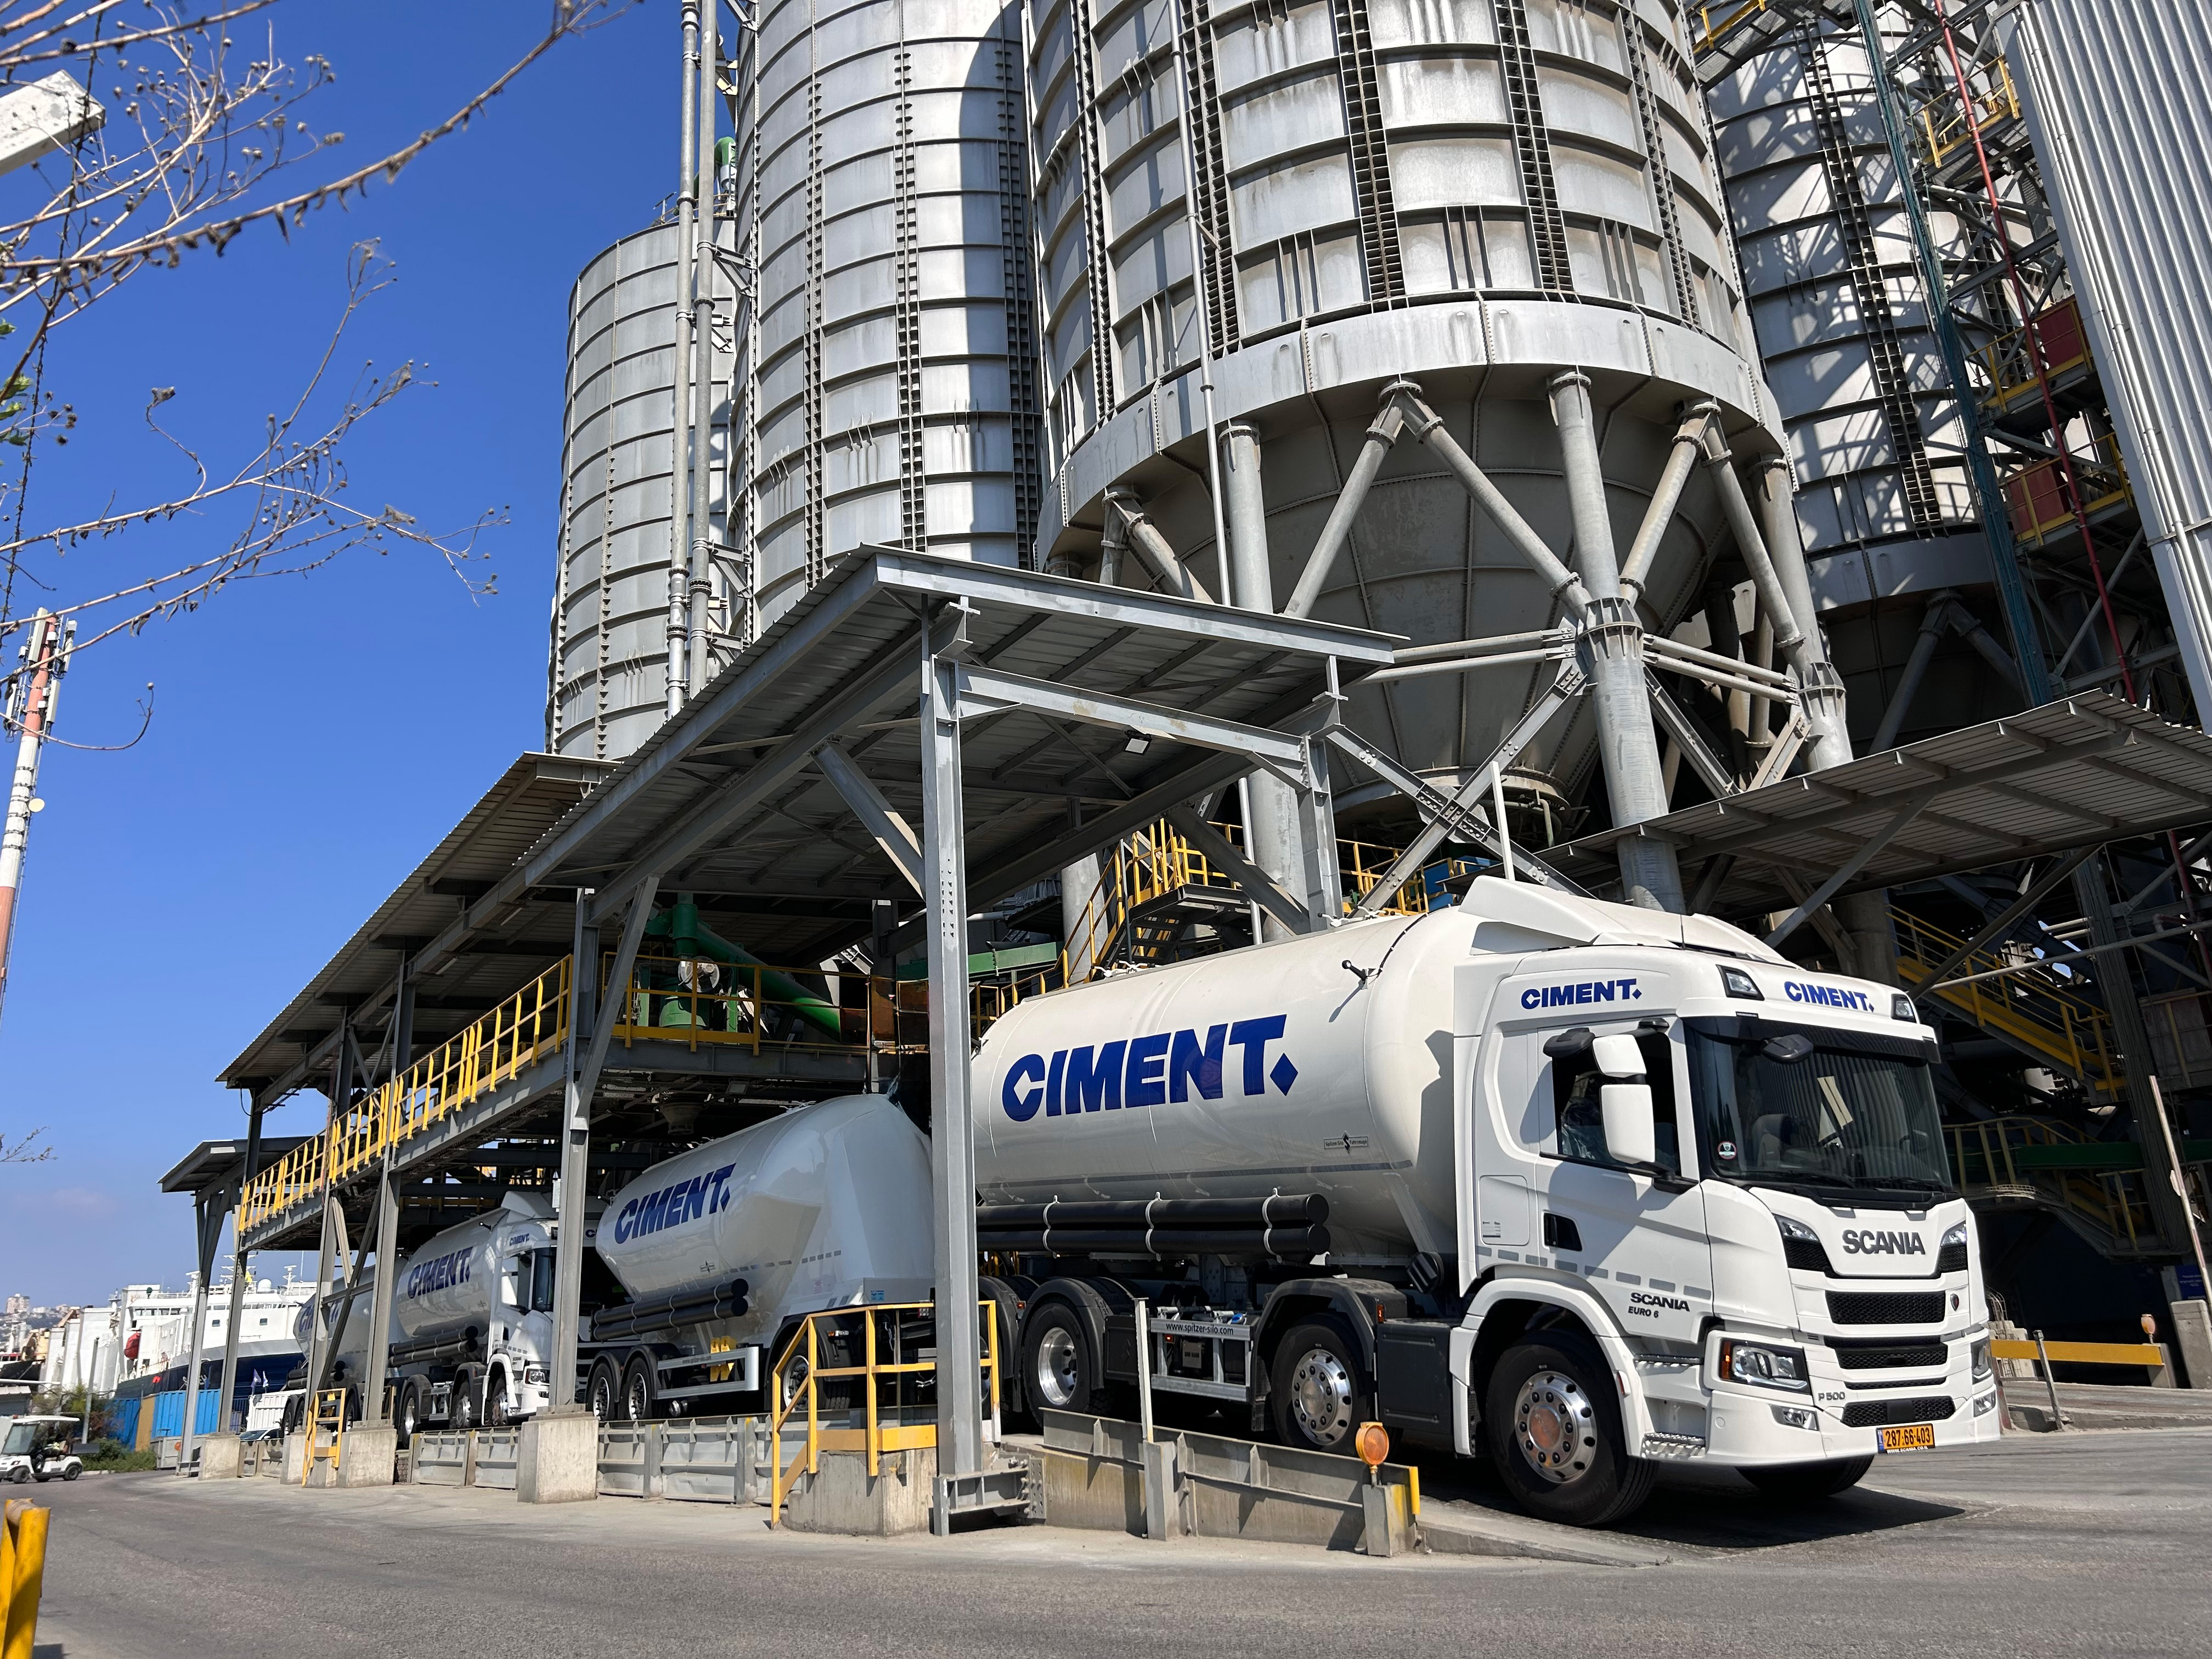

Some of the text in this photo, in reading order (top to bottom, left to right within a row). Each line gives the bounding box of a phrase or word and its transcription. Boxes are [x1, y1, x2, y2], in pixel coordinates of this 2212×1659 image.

[1842, 1229, 1926, 1255] SCANIA
[1630, 1292, 1690, 1312] SCANIA
[1628, 1306, 1651, 1317] EURO
[1166, 1323, 1234, 1335] www.spitzer-silo.com
